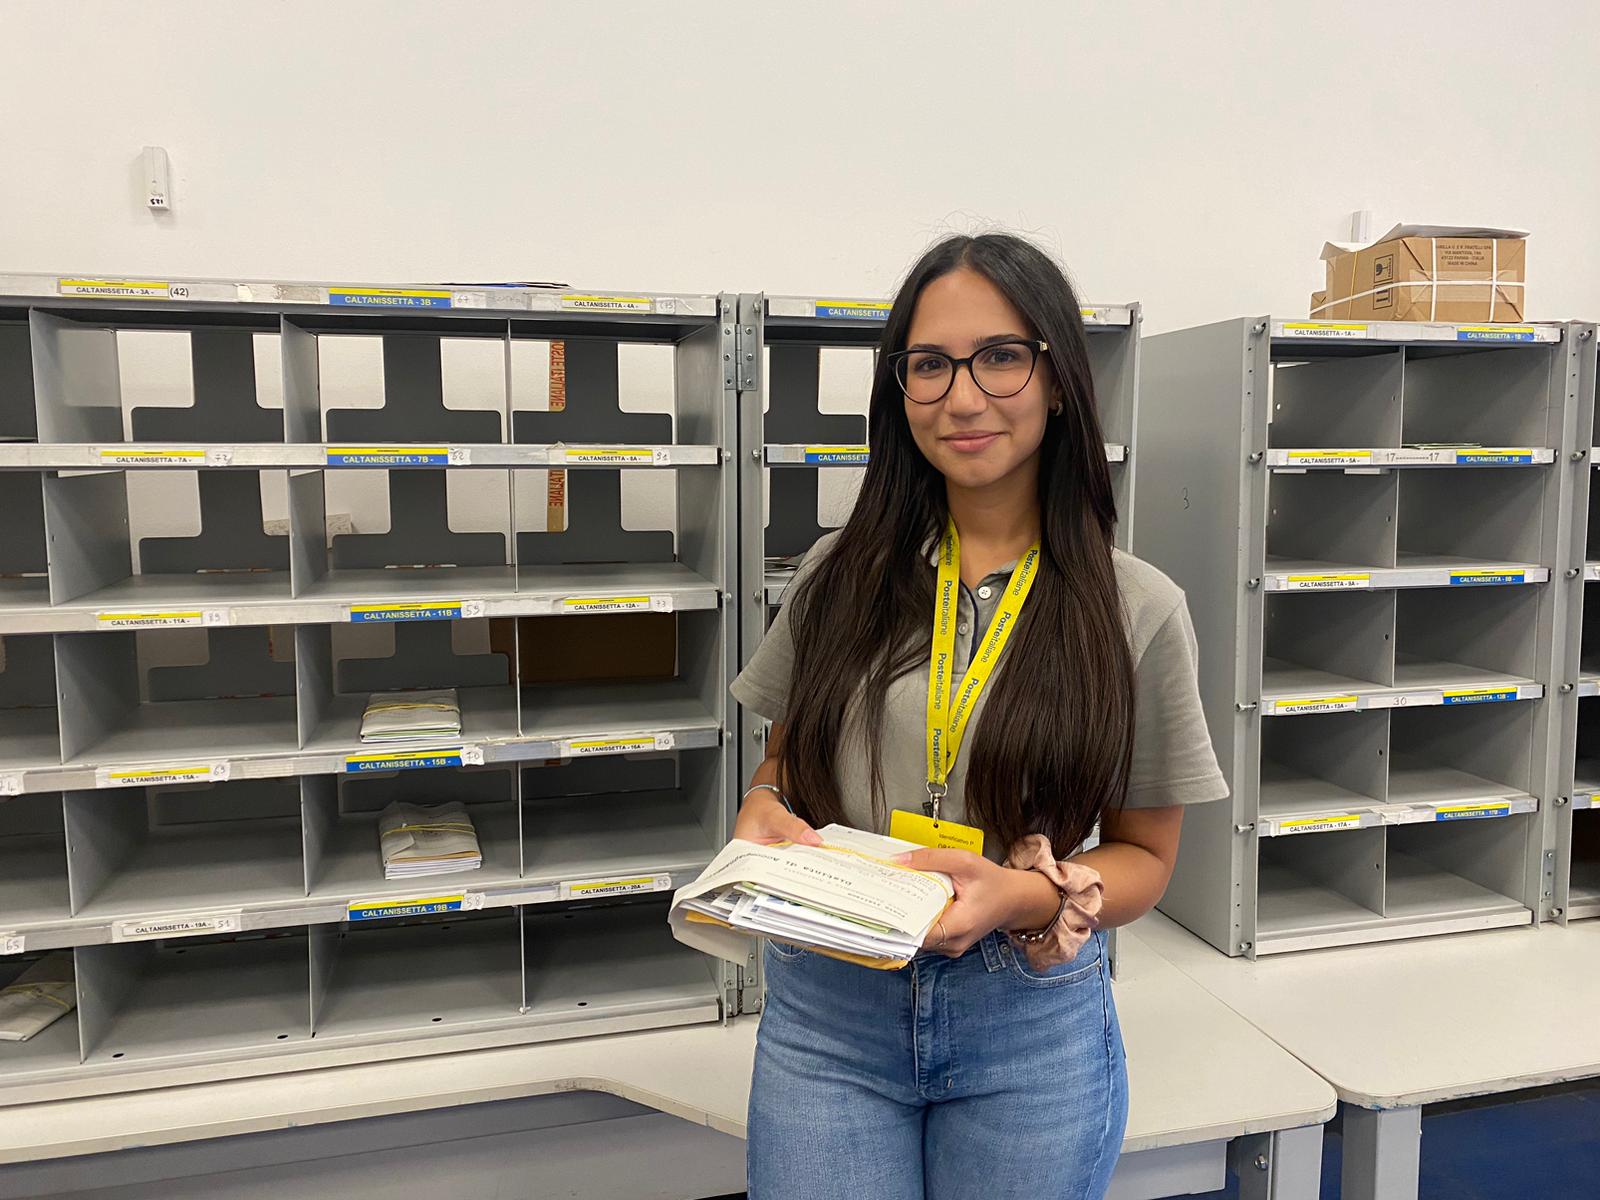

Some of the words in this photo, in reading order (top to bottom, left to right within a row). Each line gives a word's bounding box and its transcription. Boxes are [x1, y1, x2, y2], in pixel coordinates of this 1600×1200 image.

[76, 287, 134, 295] CALTANISSETTA
[170, 287, 189, 298] (42)
[344, 296, 414, 306] CALTANISSETTA
[421, 298, 431, 306] 3B
[574, 300, 621, 309] CALTANISSETTA
[828, 309, 885, 317] CALTANISSETTA
[342, 456, 412, 464] CALTANISSETTA
[818, 454, 869, 462] CALTANISSETT
[1012, 549, 1038, 596] Posteitaliane
[574, 603, 621, 611] CALTANISSETTA
[940, 580, 953, 635] Posteitaliane
[363, 611, 431, 621] CALTANISSETTA
[981, 611, 1012, 663] Posteitaliane
[934, 653, 947, 710] Posteitaliane
[1451, 695, 1493, 703] CALTANISSETTA
[950, 677, 980, 733] Posteitaliane
[1285, 704, 1330, 713] CALTANISSETTA
[580, 745, 626, 753] CALTANISSETTA
[358, 760, 425, 771] CALTANISSETTA
[121, 775, 177, 784] CALTANISSETTA
[1443, 811, 1485, 819] CALTANISSETTA
[1289, 824, 1334, 833] CALTANISSETTA
[581, 885, 627, 895] CALTANISSETTA
[362, 905, 427, 918] CALTANISSETTA
[135, 923, 190, 934] CALTANISSETTA
